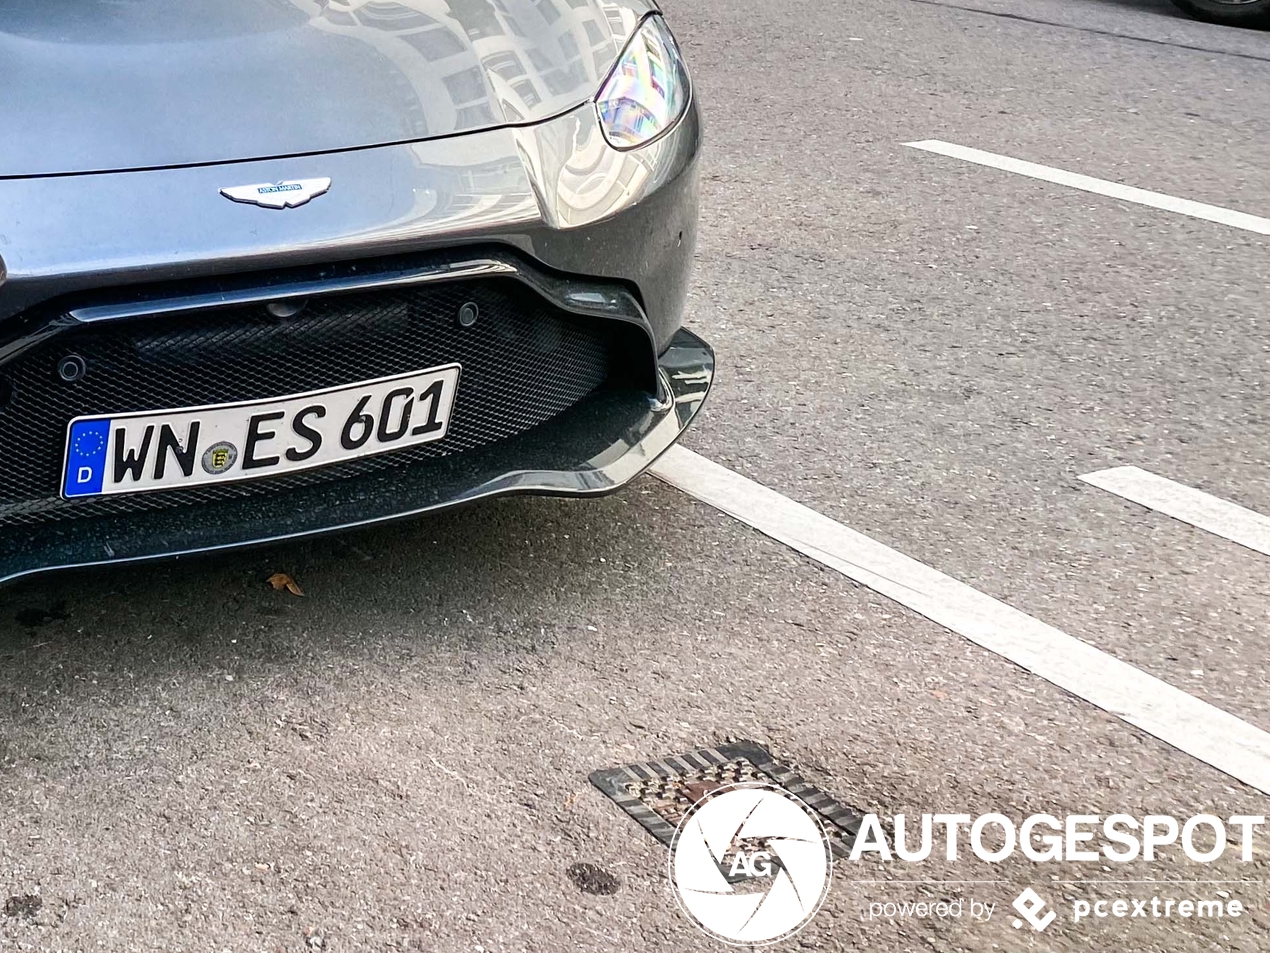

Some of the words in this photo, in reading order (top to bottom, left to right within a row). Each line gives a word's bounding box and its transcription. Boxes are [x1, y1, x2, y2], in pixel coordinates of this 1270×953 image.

[76, 466, 92, 484] D
[113, 420, 201, 484] WN
[241, 404, 327, 470] ES
[340, 379, 446, 450] 601
